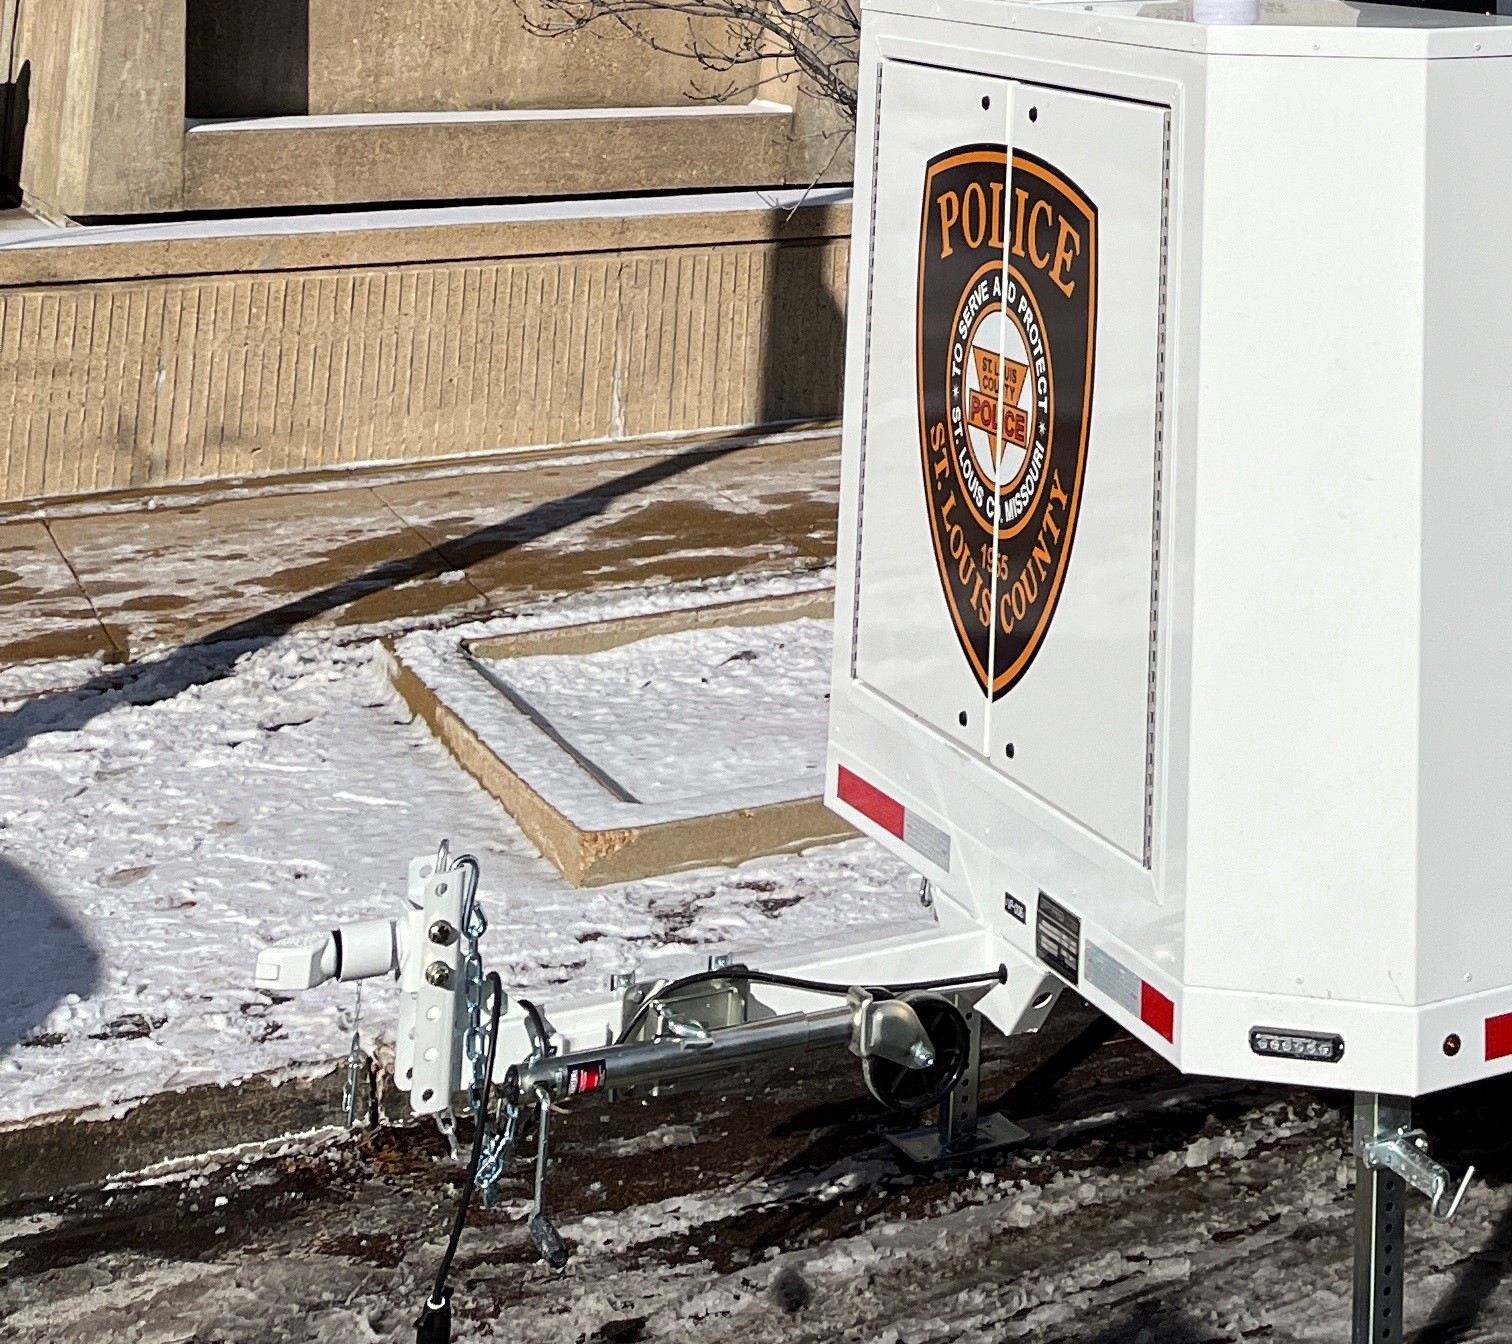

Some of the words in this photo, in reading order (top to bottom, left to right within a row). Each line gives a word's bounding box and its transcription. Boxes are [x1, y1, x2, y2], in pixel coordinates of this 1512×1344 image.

[937, 182, 1080, 298] POLICE
[952, 343, 963, 376] TO
[959, 279, 989, 340] SERVE
[993, 276, 1016, 303] AD
[1018, 295, 1048, 413] PROTECT
[994, 361, 1017, 384] LUIS
[952, 406, 963, 445] ST.
[959, 447, 984, 507] LOUIS
[1004, 441, 1044, 522] MISSOURI
[971, 395, 1025, 442] POLCE
[930, 422, 950, 491] ST.
[941, 490, 992, 627] LOUIS
[1000, 469, 1068, 634] COUNTY
